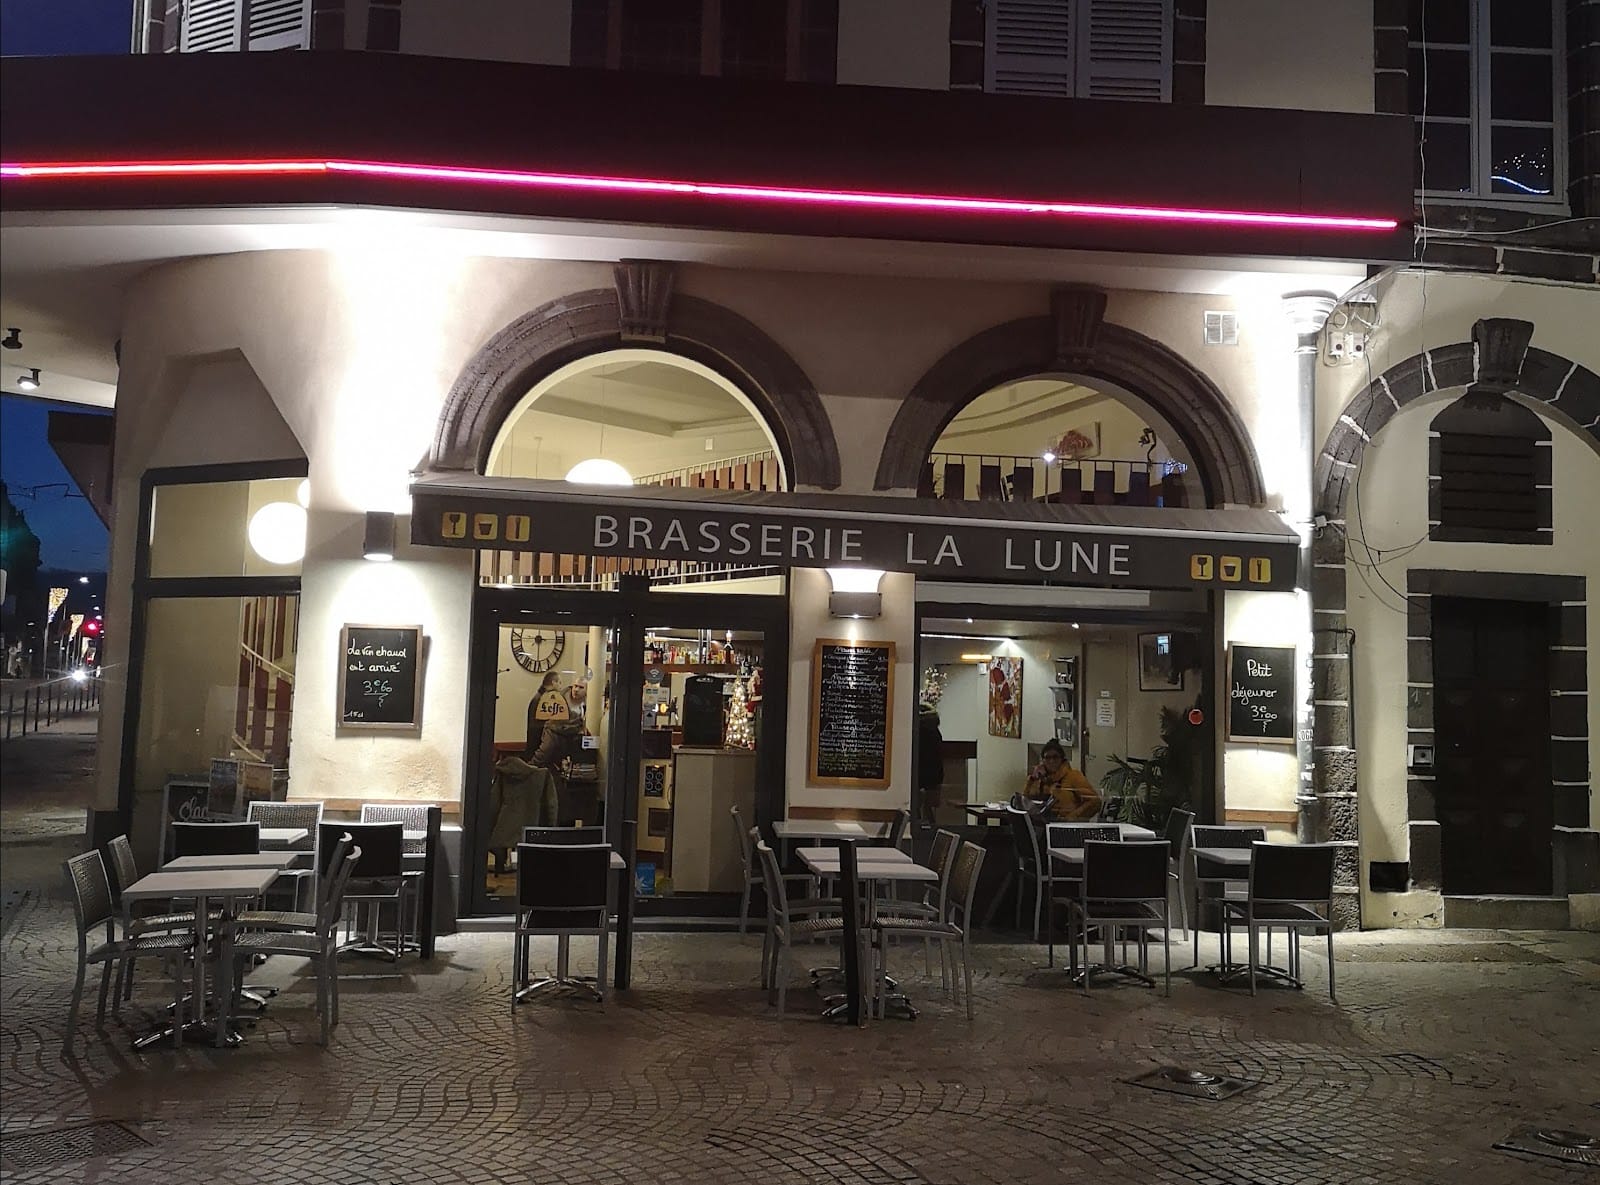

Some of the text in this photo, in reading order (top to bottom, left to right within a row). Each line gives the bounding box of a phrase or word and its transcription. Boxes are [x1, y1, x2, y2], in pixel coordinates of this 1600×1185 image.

[594, 515, 1131, 576] BRASSERIE LA LUNE
[362, 642, 374, 656] vin
[376, 645, 407, 658] chaud
[349, 661, 401, 673] est arrivé
[1246, 659, 1272, 677] Petit
[1231, 681, 1278, 705] déjeuner
[540, 702, 564, 716] Leffe
